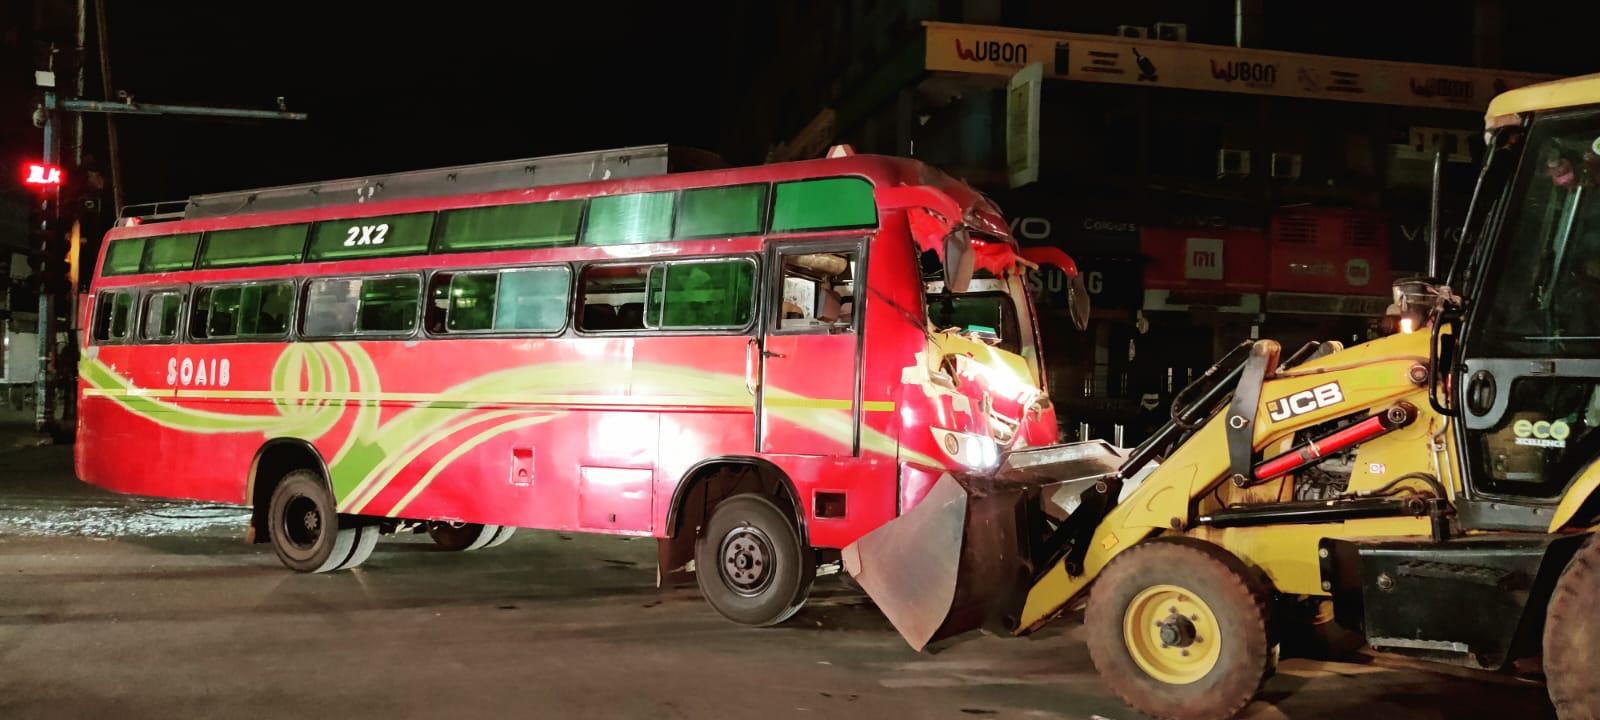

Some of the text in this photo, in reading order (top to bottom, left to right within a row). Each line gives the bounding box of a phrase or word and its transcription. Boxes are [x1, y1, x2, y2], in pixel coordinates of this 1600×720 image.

[955, 39, 1027, 63] WUBON
[1210, 59, 1276, 83] WUBON
[343, 223, 389, 247] 2X2
[1083, 217, 1136, 232] Colours
[167, 357, 230, 386] SOAIB
[1270, 382, 1344, 421] JCB
